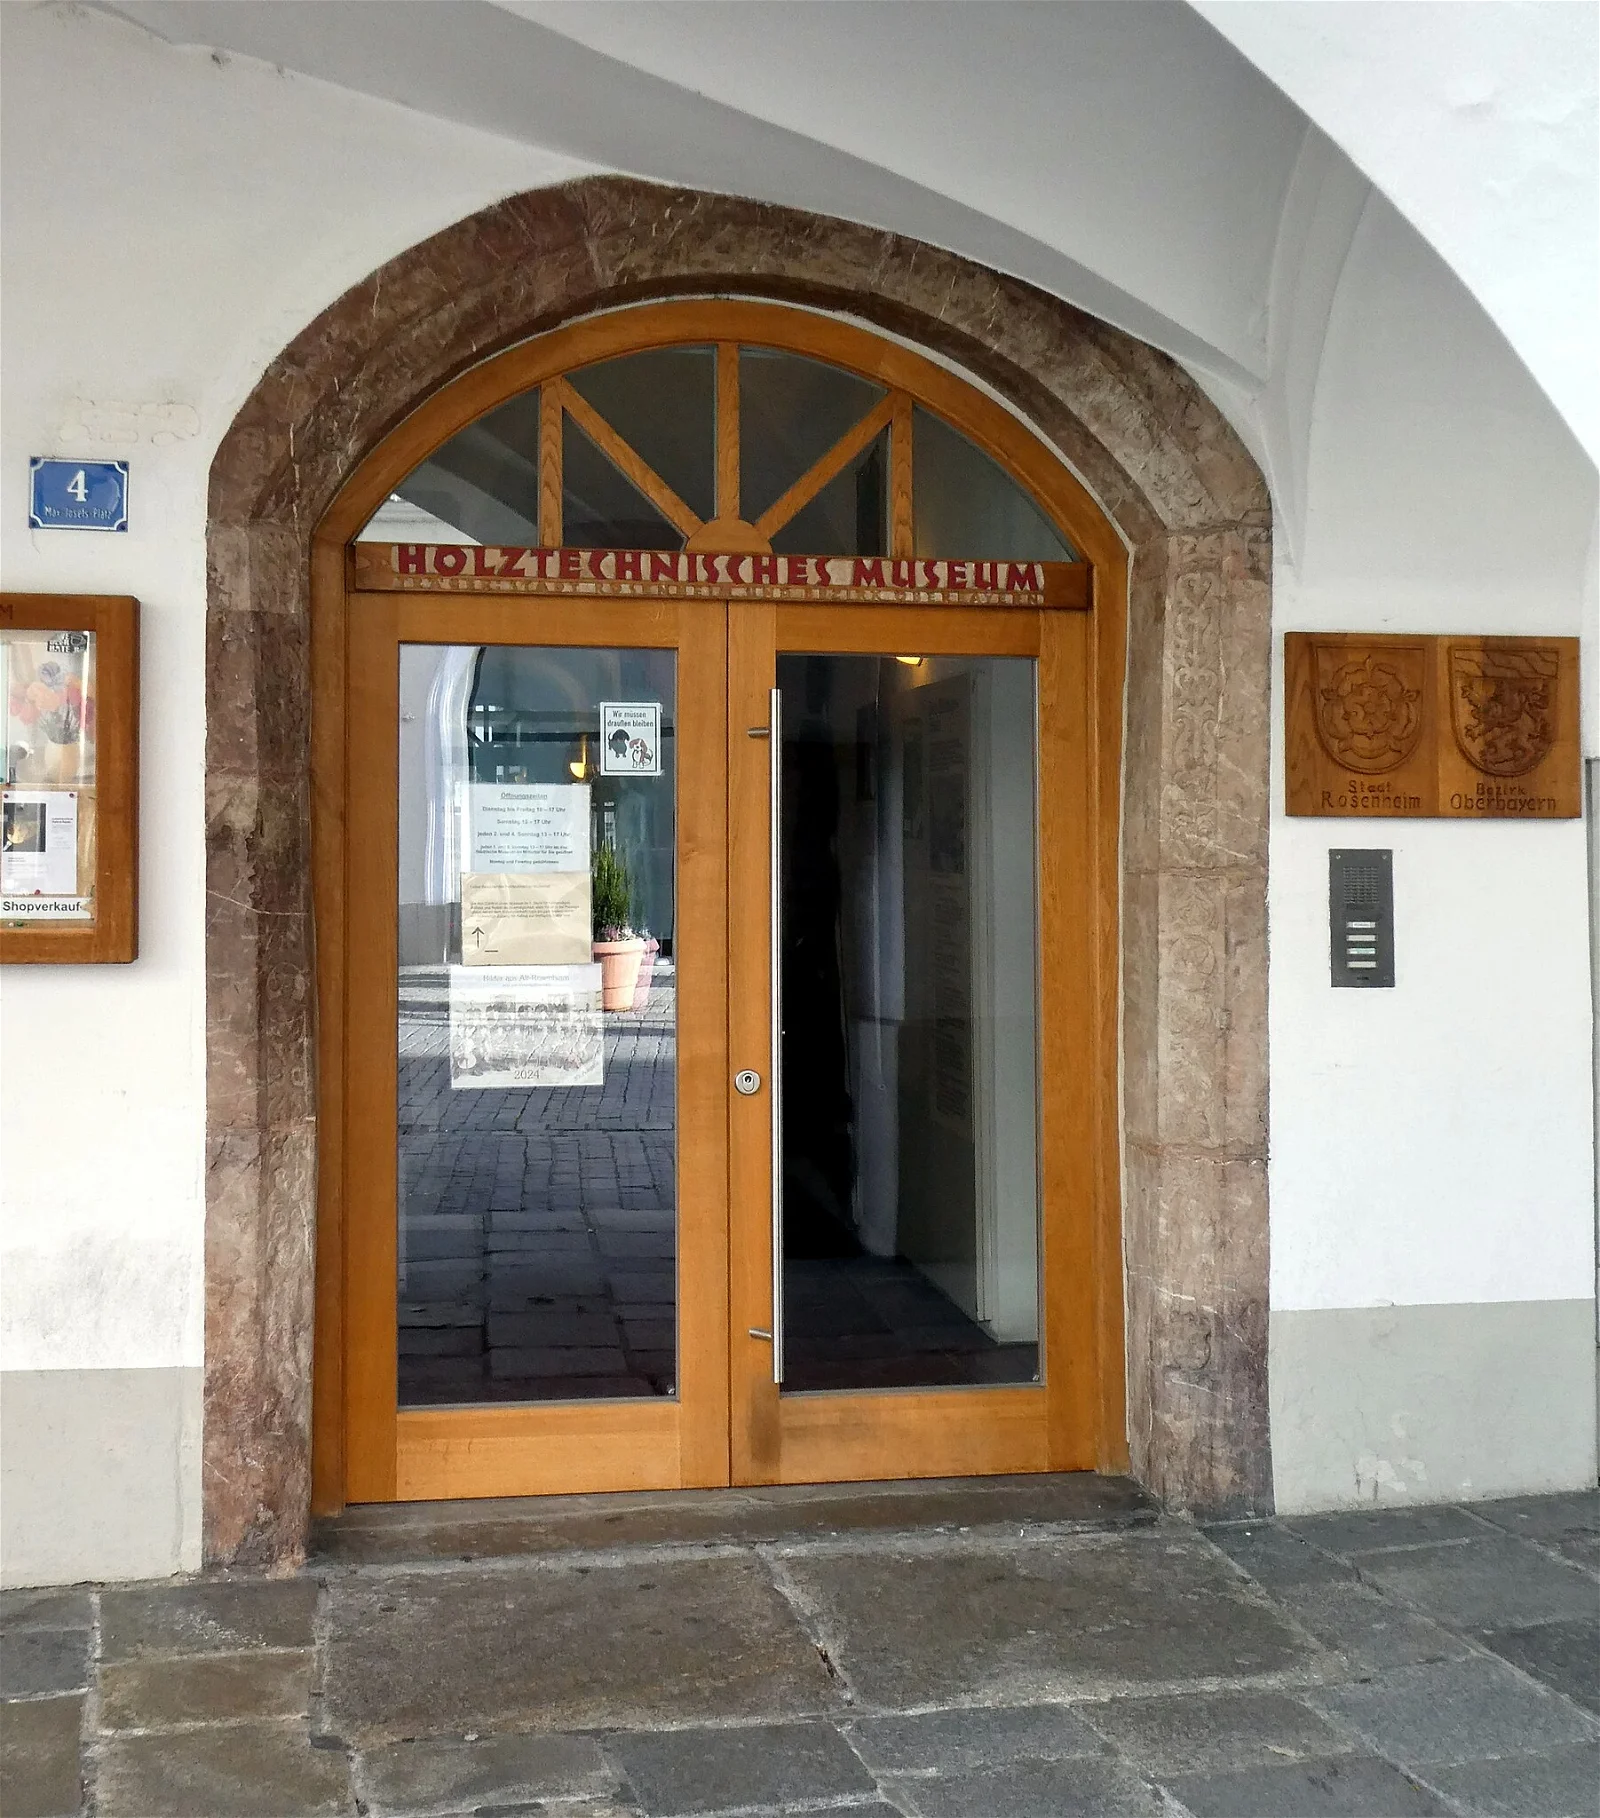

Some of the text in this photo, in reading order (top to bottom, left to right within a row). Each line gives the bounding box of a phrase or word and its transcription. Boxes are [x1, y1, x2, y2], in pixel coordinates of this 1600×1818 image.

[67, 469, 89, 502] 4
[399, 545, 1039, 592] HOLZTECHNISCHES MUSEUM
[1476, 782, 1528, 796] Bezirk
[1321, 788, 1422, 809] Rosenheim
[1450, 793, 1557, 811] Oberbayern
[2, 901, 81, 914] Shopverkauf
[514, 1069, 540, 1080] 2024
